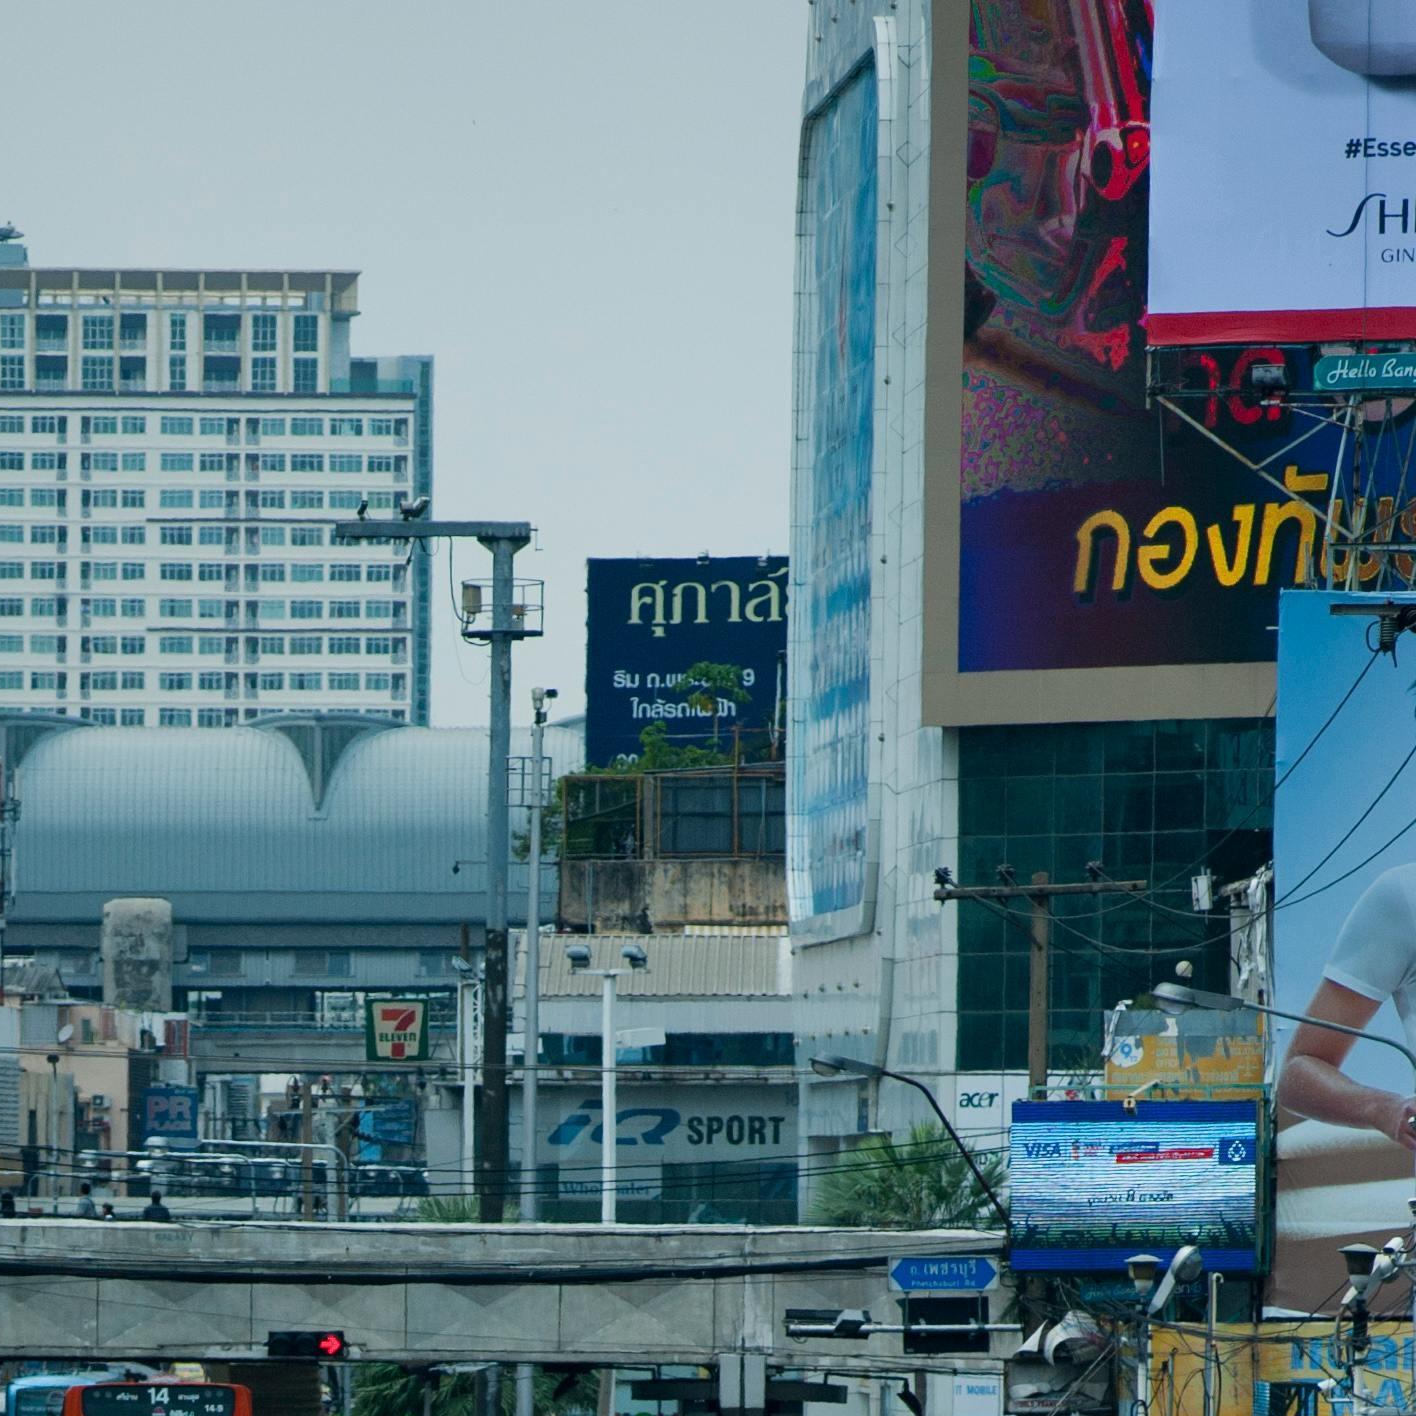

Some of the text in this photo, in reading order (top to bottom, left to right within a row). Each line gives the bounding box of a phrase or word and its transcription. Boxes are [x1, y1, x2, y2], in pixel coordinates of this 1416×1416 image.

[1326, 192, 1416, 238] SH
[1327, 359, 1377, 384] Hello
[613, 670, 640, 689] ริม
[959, 1091, 999, 1108] acer
[687, 1115, 785, 1146] SPORT
[147, 1387, 170, 1405] 14
